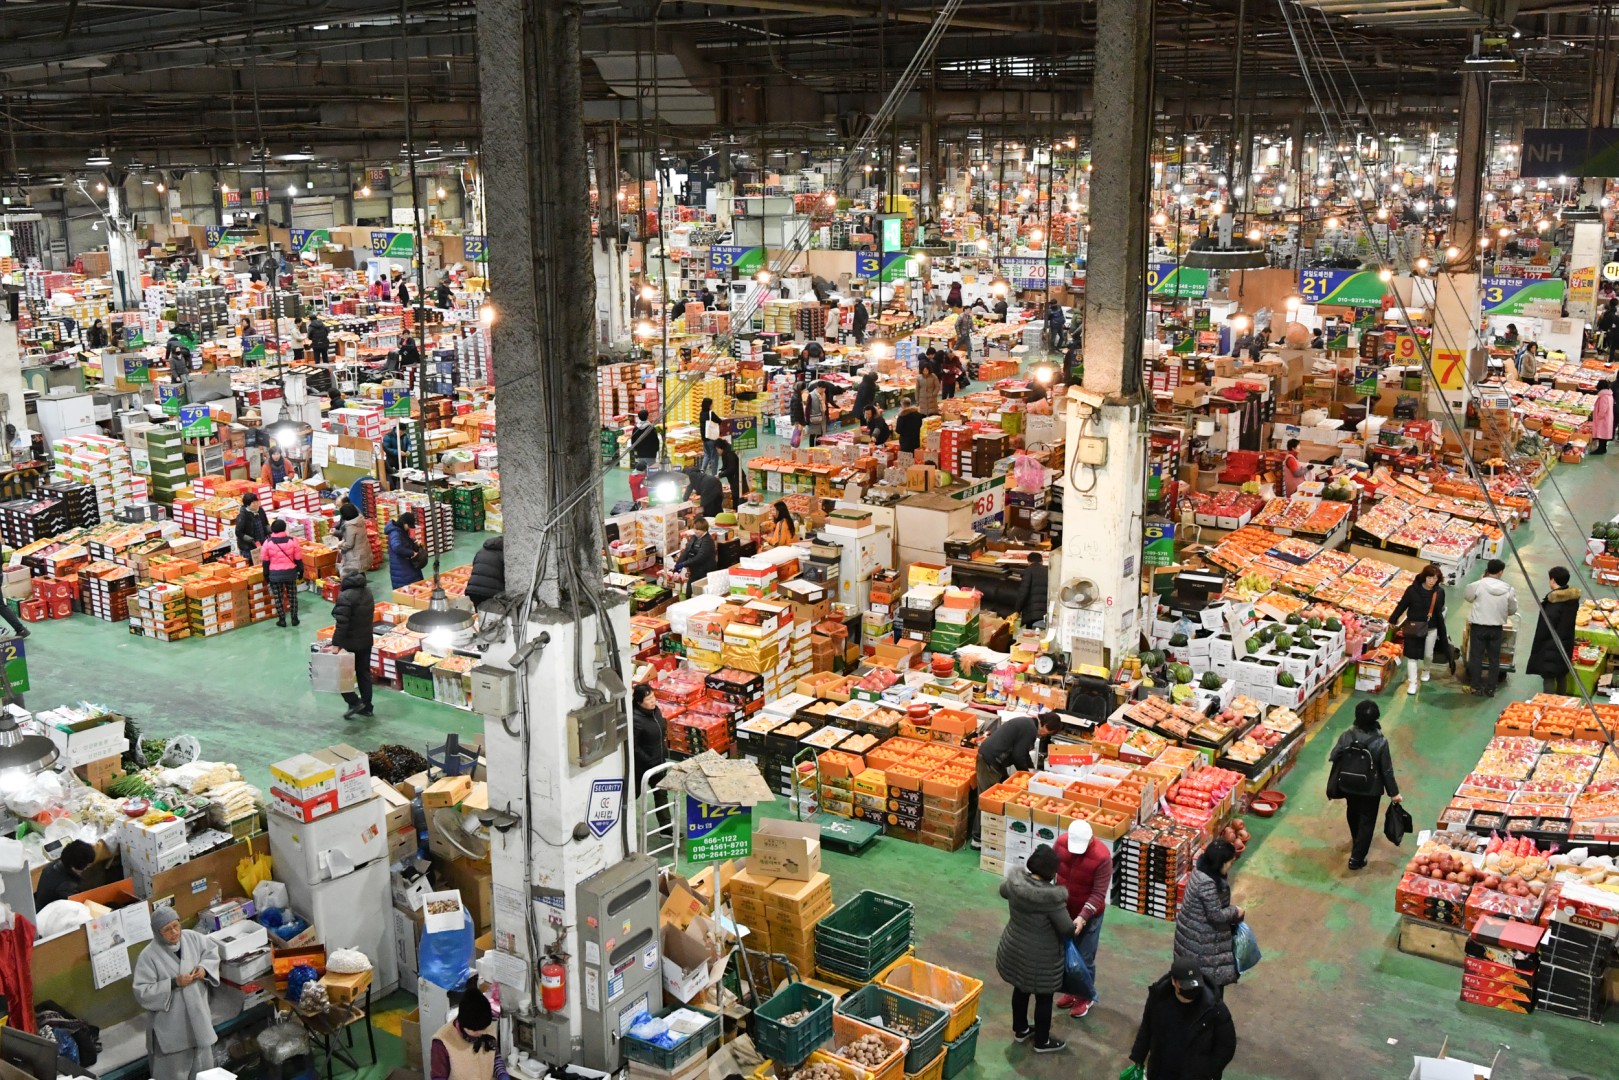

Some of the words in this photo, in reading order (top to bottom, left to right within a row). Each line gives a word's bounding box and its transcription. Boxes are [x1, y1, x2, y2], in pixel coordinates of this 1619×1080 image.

[1527, 144, 1564, 162] NH
[207, 231, 220, 243] 33
[292, 234, 303, 246] 41
[374, 238, 386, 250] 50
[466, 242, 482, 252] 22
[712, 253, 732, 264] 53
[862, 258, 880, 272] 3
[1030, 266, 1046, 278] 20
[1302, 278, 1327, 294] 21
[1400, 338, 1414, 358] 9
[1438, 354, 1462, 384] 7
[187, 410, 203, 418] 79
[736, 420, 752, 430] 60
[978, 494, 994, 516] 68
[1145, 526, 1163, 538] 6
[1106, 596, 1112, 606] 6
[594, 784, 620, 792] SECURITY
[704, 835, 737, 844] 666-1122
